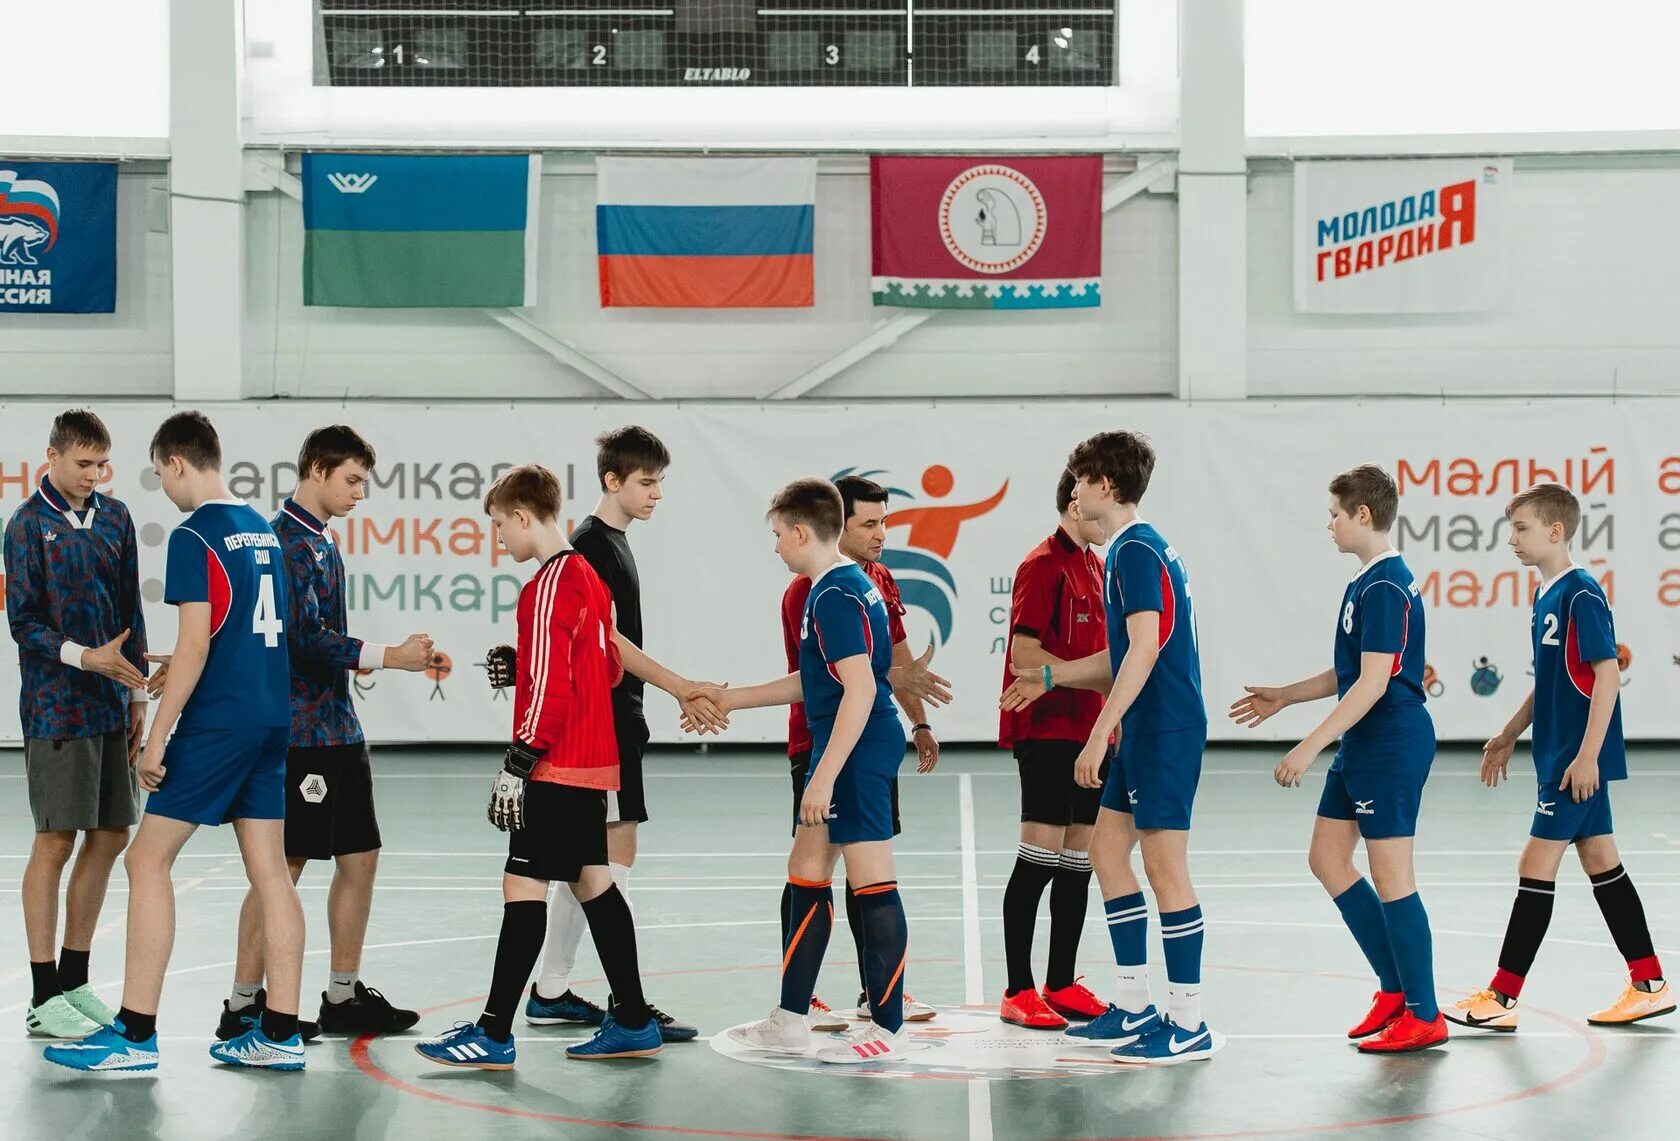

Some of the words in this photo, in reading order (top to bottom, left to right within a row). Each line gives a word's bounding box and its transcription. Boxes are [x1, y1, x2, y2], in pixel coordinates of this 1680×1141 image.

[392, 44, 403, 64] 1
[592, 45, 607, 65] 2
[825, 45, 840, 65] 3
[1025, 45, 1040, 65] 4
[684, 67, 751, 81] ELTABLO
[223, 533, 281, 552] ПЕРЕГРЕБИНС
[1397, 503, 1615, 552] малй
[252, 574, 284, 648] 4
[1342, 600, 1355, 635] 8
[1541, 613, 1560, 646] 2
